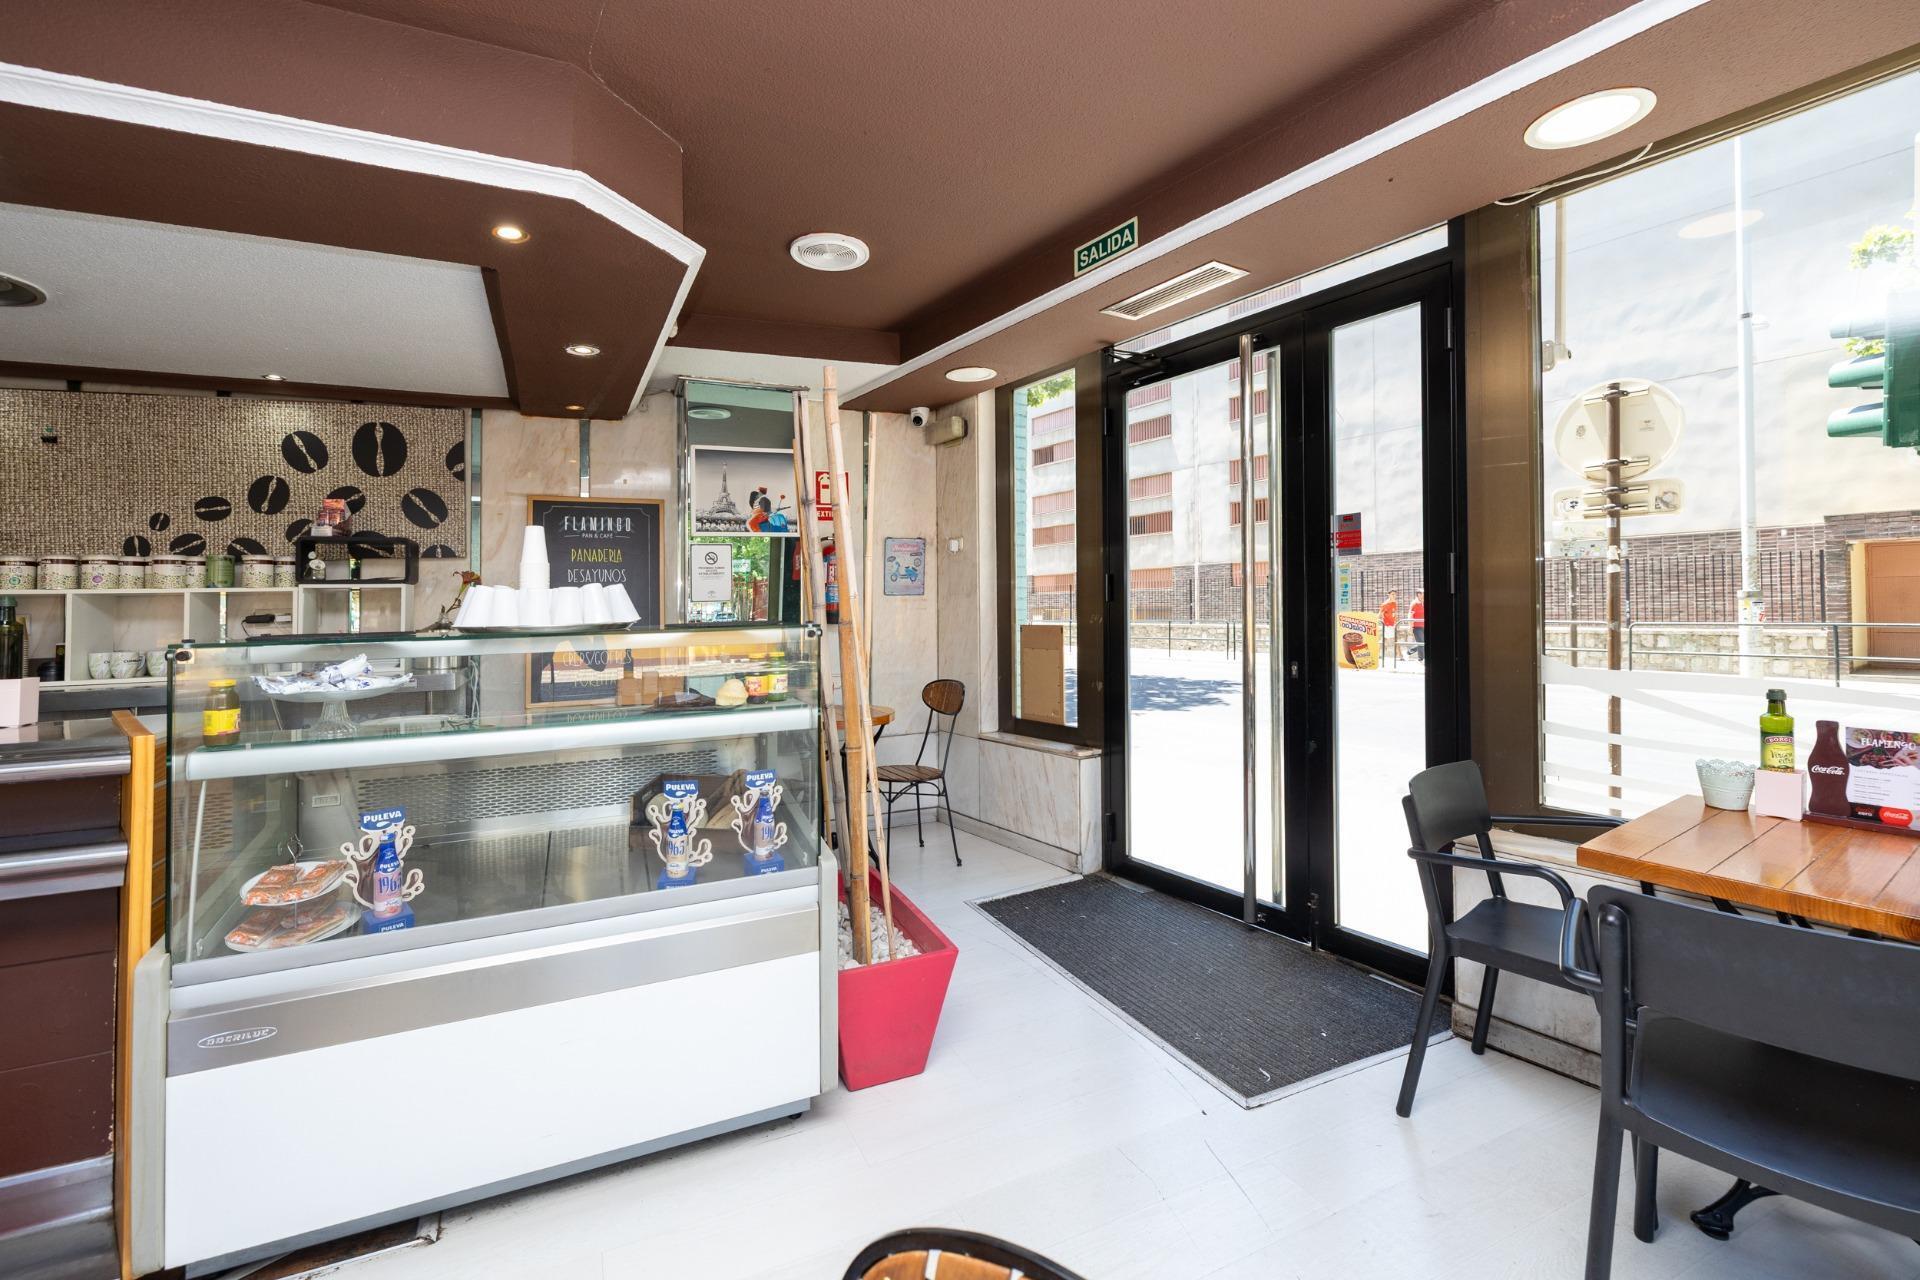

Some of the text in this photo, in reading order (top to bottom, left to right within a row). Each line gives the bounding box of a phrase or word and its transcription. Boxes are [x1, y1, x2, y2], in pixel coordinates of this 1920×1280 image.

[1080, 228, 1133, 267] SALIDA
[816, 510, 834, 518] EXTI
[564, 516, 632, 532] FLAMINGO
[567, 568, 627, 583] DESAYUNOS
[1860, 737, 1917, 750] FLAMINGO
[1811, 764, 1845, 775] Coca-Cola
[746, 772, 774, 782] PULEVA
[666, 783, 696, 791] PULEVA
[363, 810, 402, 823] PULEVA
